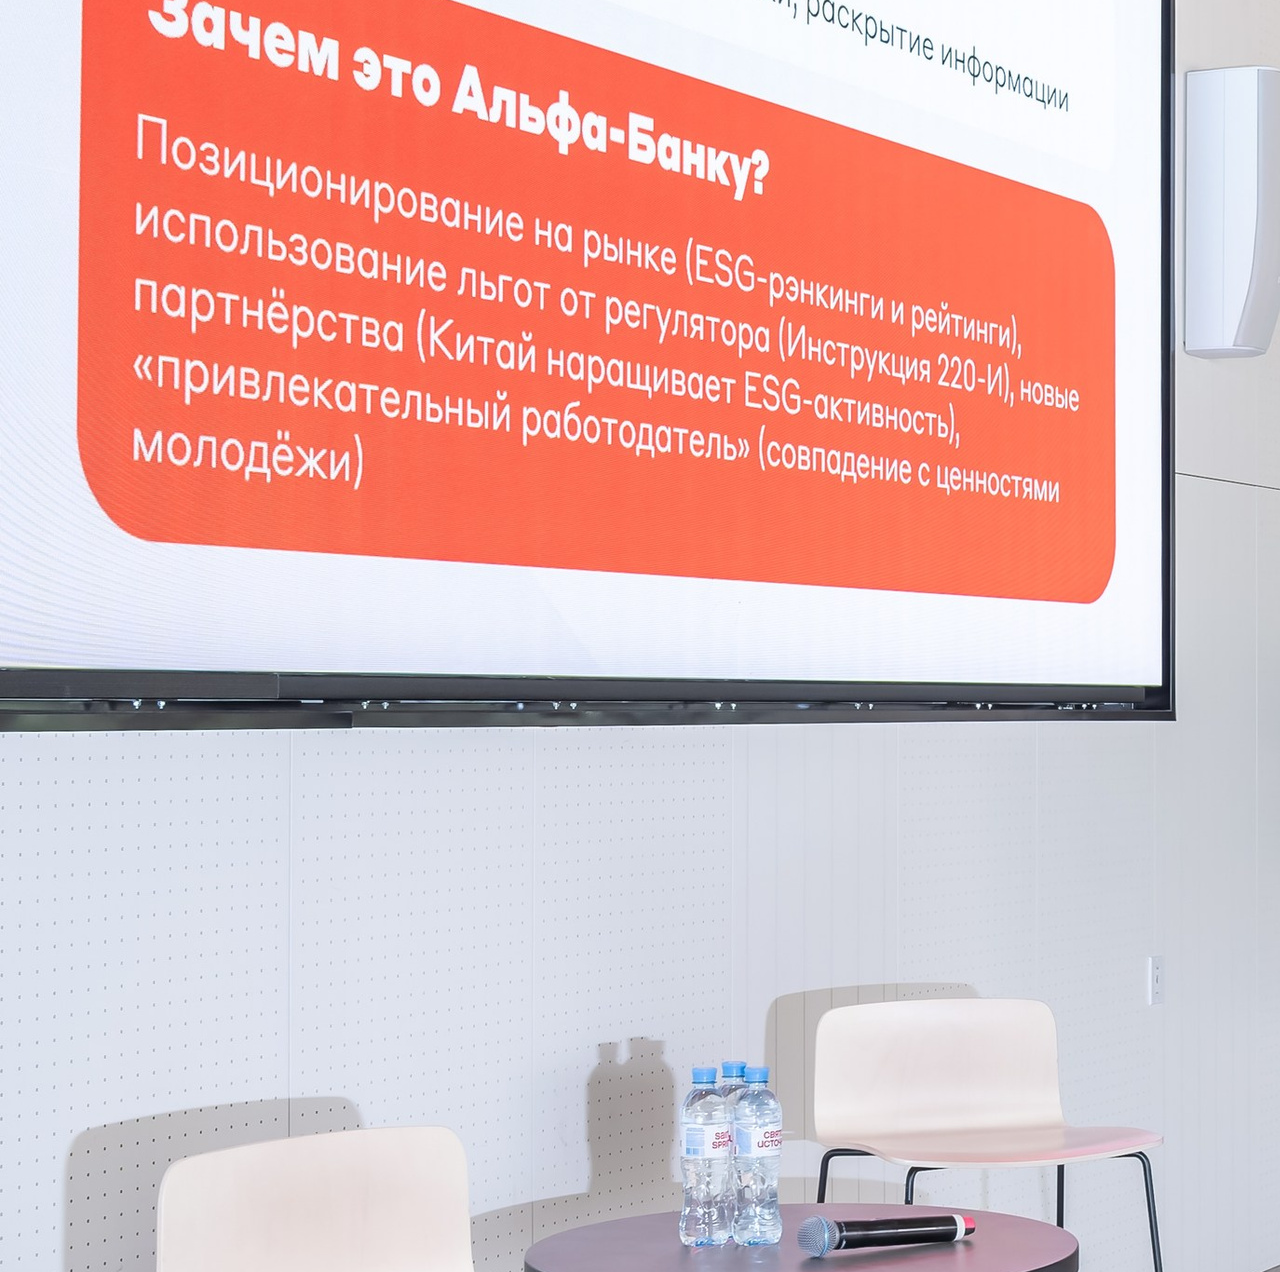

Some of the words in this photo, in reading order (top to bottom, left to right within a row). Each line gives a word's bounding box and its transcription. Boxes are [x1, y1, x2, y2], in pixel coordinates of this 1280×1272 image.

[352, 46, 441, 107] это
[451, 63, 770, 202] Альфа-Банку?
[941, 44, 1069, 112] информации
[135, 202, 447, 292] использование
[457, 266, 551, 310] льгот
[560, 287, 597, 319] от
[605, 295, 770, 359] регулятора
[778, 315, 931, 386] (Инструкция
[937, 352, 1015, 408] 220-И),
[1020, 379, 1080, 412] новые
[137, 113, 524, 242] Позиционирование
[534, 217, 573, 253] на
[583, 228, 677, 276] рынке
[685, 237, 884, 321] (ESG-рэнкинги
[891, 299, 904, 325] и
[911, 304, 1022, 360] рейтинги),
[133, 354, 511, 433] «привлекательный
[522, 400, 750, 461] работодатель»
[758, 424, 912, 485] (совпадение
[917, 462, 931, 487] с
[936, 464, 1060, 503] ценностями
[134, 277, 404, 352] партнёрства
[416, 308, 536, 373] (Китай
[547, 347, 737, 404] наращивает
[744, 370, 960, 449] ESG-активность),
[133, 427, 363, 490] молодёжи)
